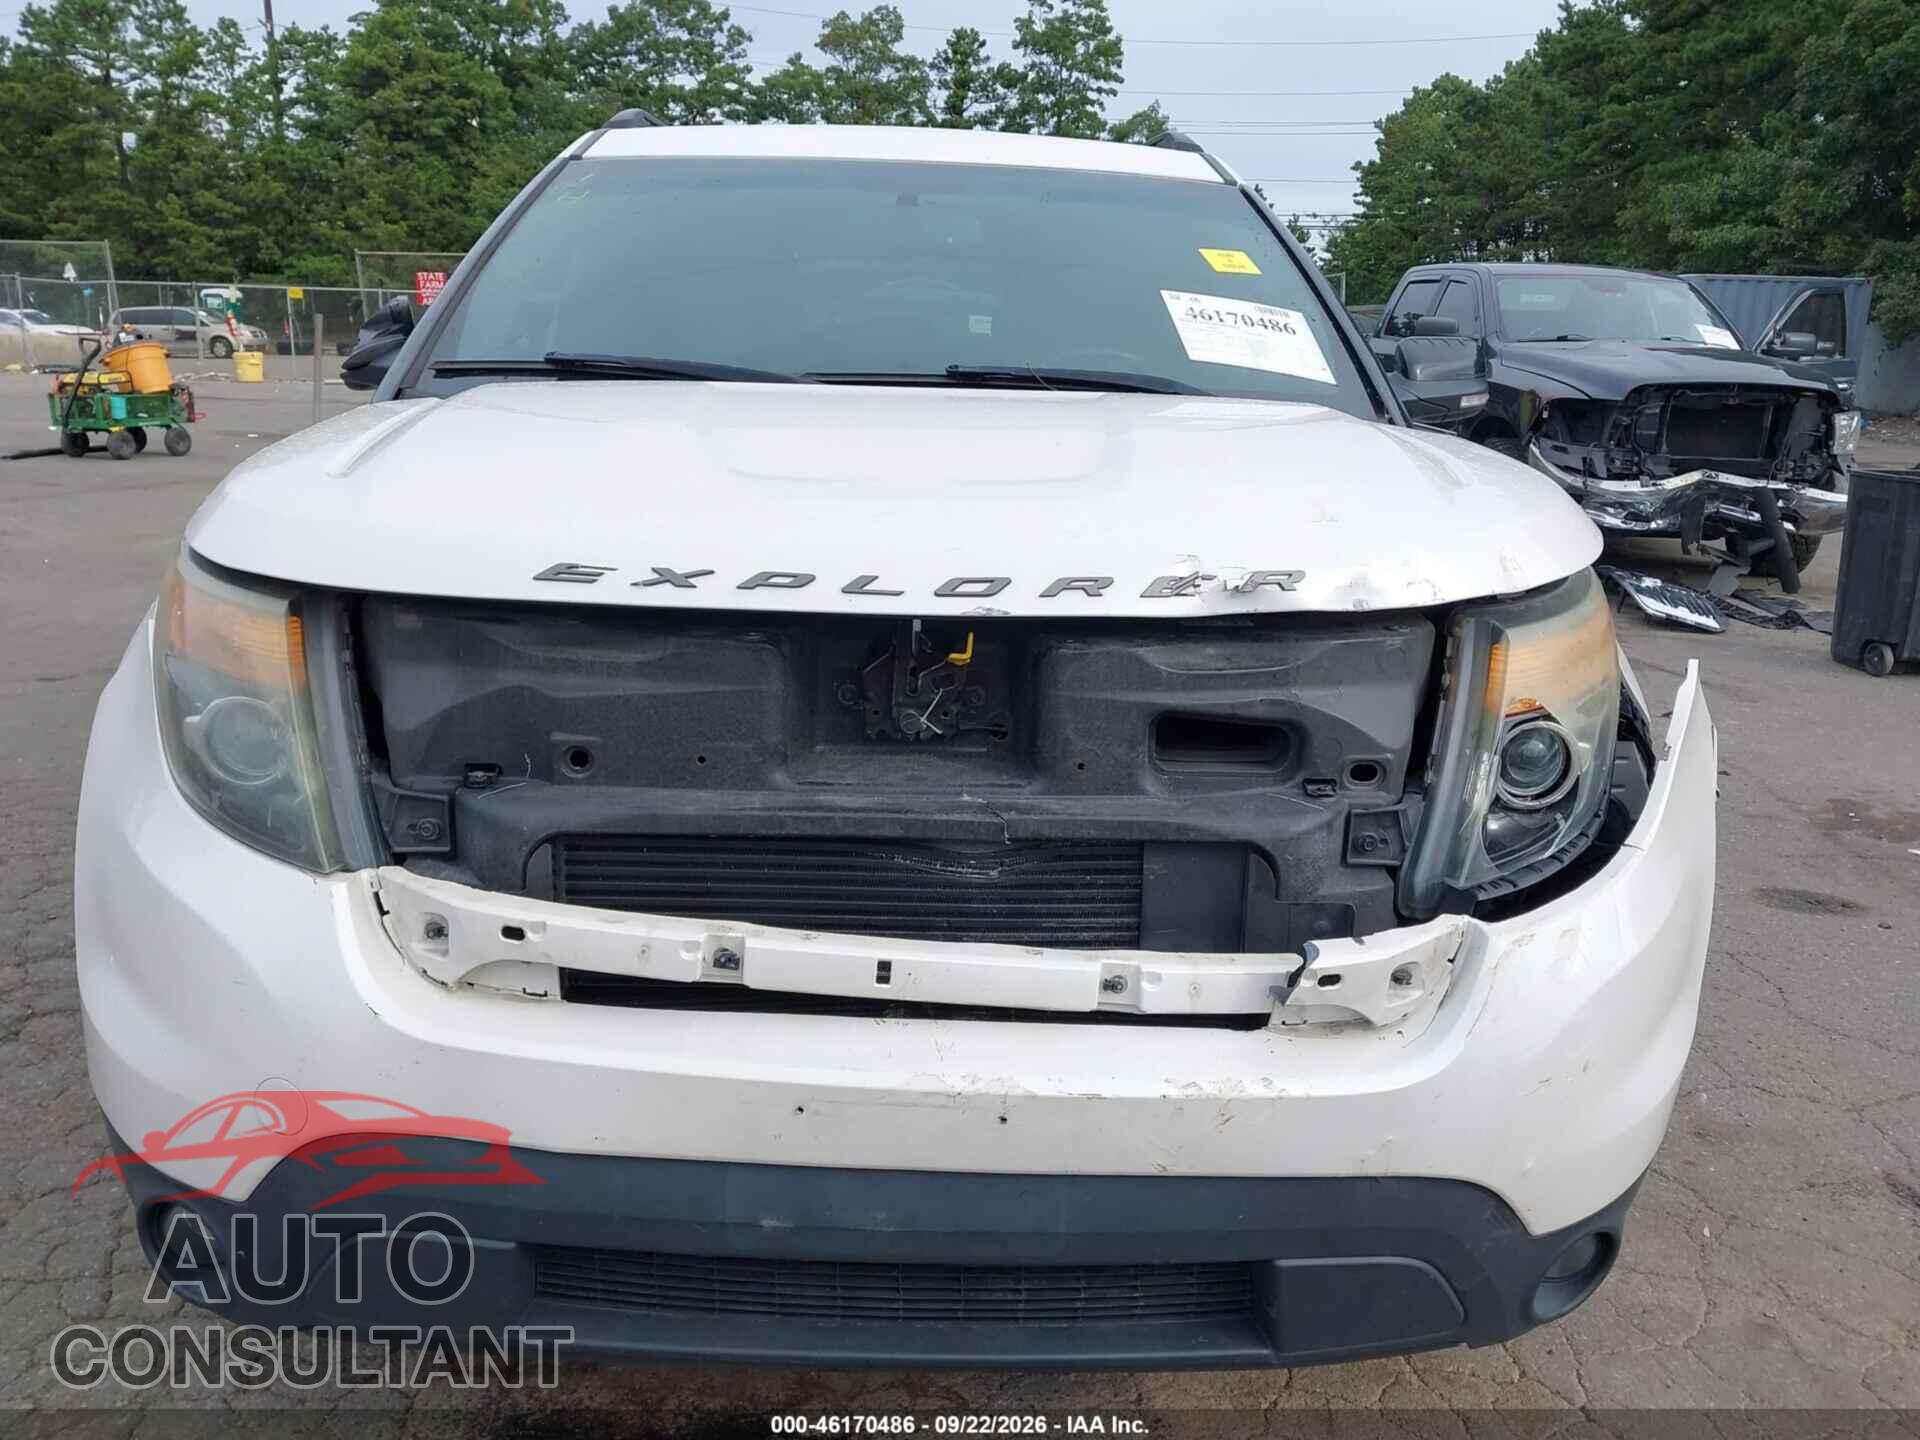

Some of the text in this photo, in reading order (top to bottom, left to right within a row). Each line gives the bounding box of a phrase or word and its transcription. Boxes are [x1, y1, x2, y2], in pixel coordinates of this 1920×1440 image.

[416, 272, 446, 280] STATE
[1184, 307, 1297, 335] 46170486
[533, 563, 1306, 598] EXPLORER
